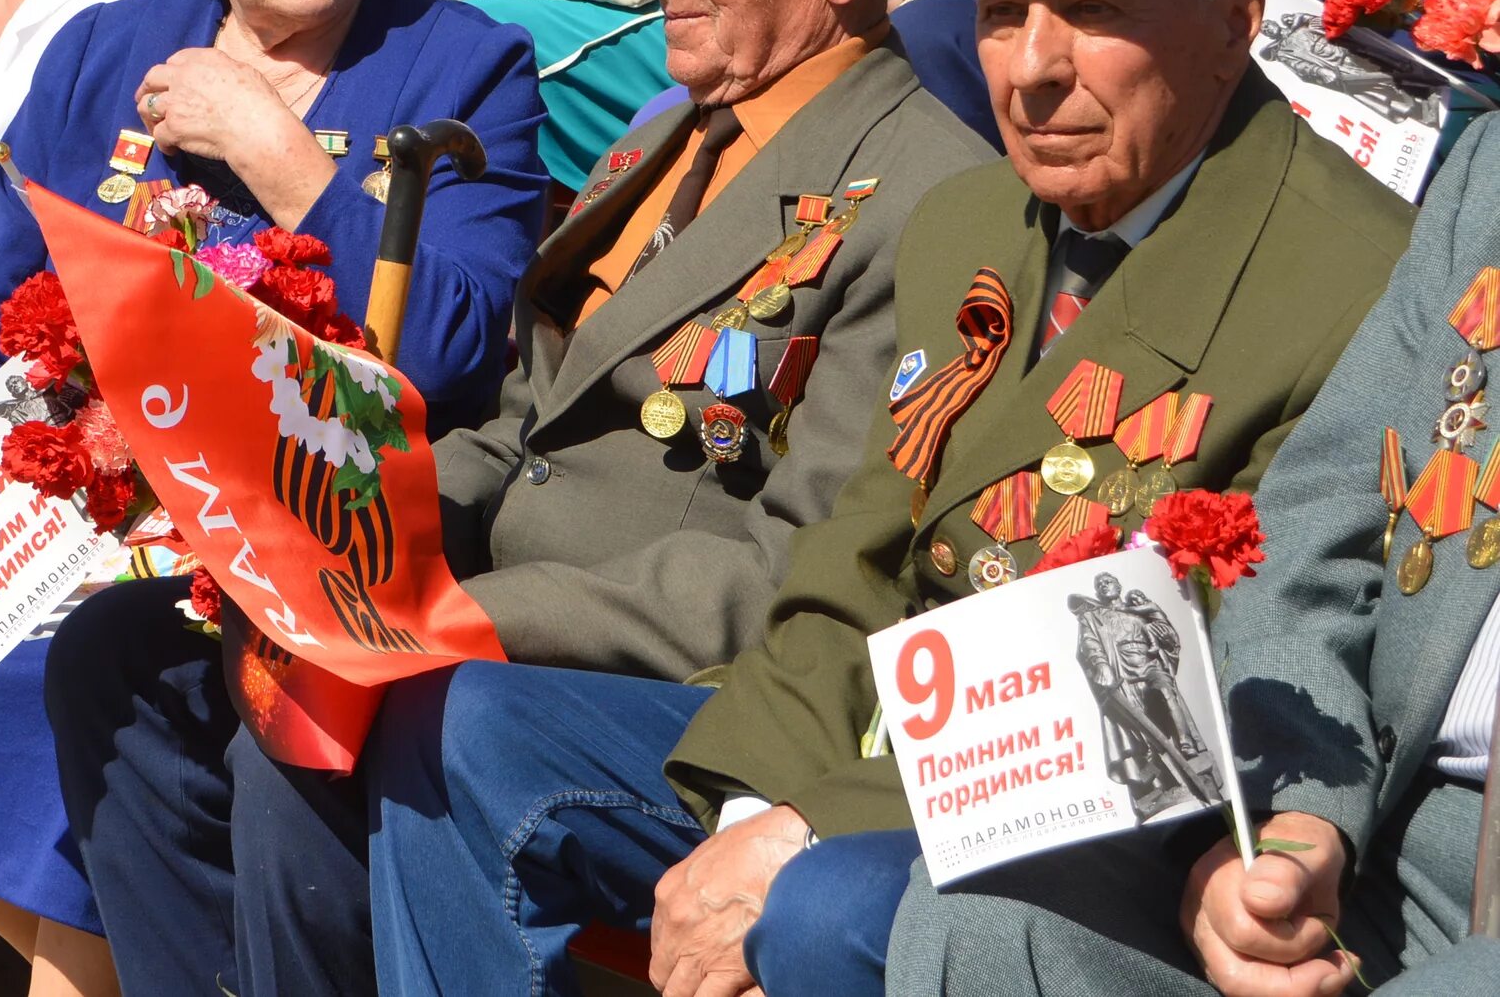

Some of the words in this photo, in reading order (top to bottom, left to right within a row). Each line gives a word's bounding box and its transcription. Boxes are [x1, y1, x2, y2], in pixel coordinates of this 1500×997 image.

[1335, 114, 1355, 138] и
[1353, 121, 1381, 168] ся!
[1386, 133, 1419, 191] ОНОВЪ
[32, 492, 49, 517] и
[895, 628, 955, 741] 9
[965, 661, 1051, 714] мая
[918, 725, 1041, 787] Помним
[1052, 716, 1074, 742] и
[926, 741, 1085, 819] гордимся!
[961, 796, 1114, 850] ПАРАМОНОВЪ
